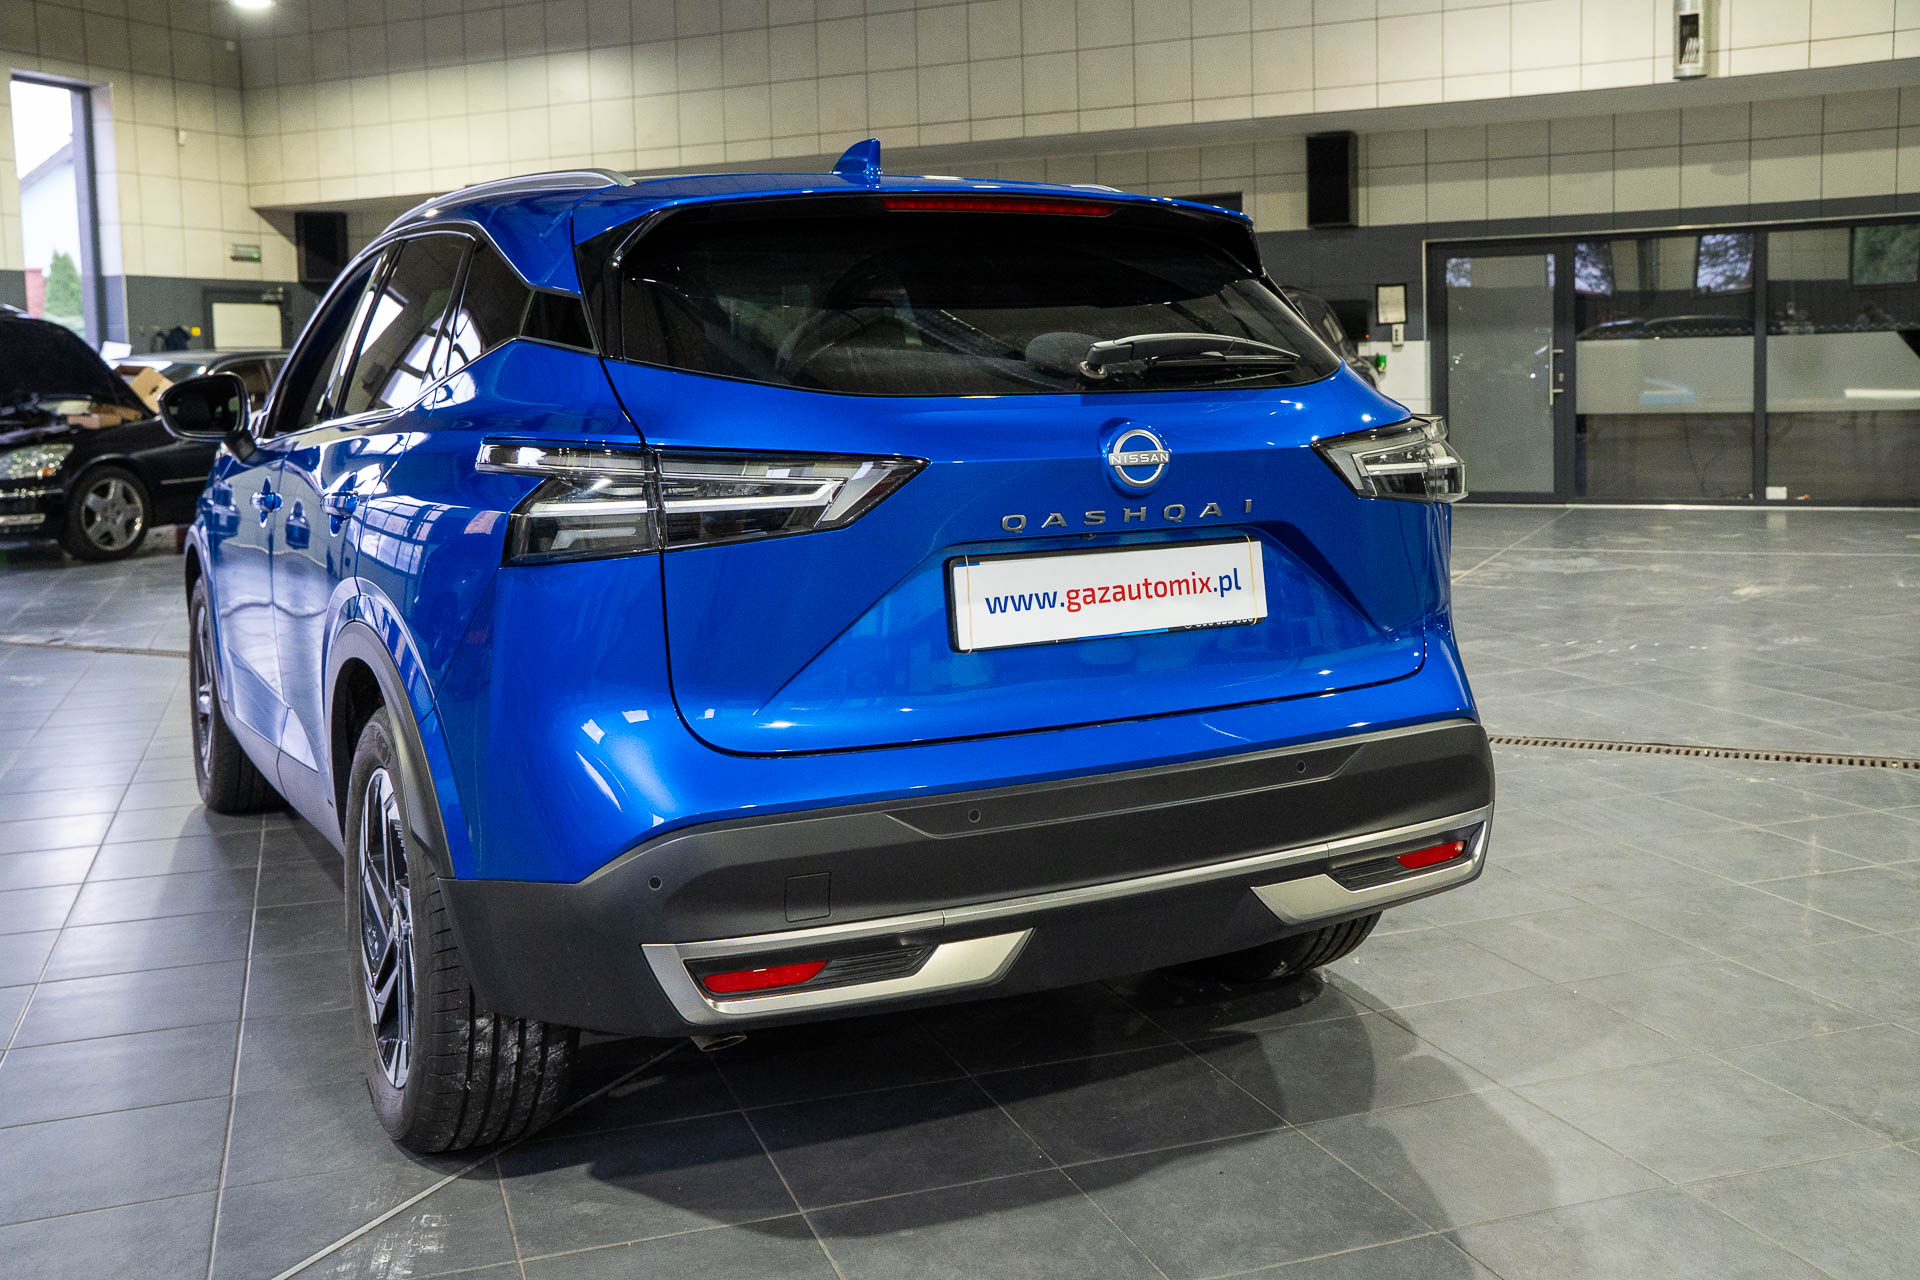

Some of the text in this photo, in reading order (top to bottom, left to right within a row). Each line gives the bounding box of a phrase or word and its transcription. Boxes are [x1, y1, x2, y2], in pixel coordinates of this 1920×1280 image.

[1110, 453, 1169, 465] NISSAN
[1001, 498, 1252, 533] QASHQAI
[985, 568, 1242, 614] www.gazautomix.pl
